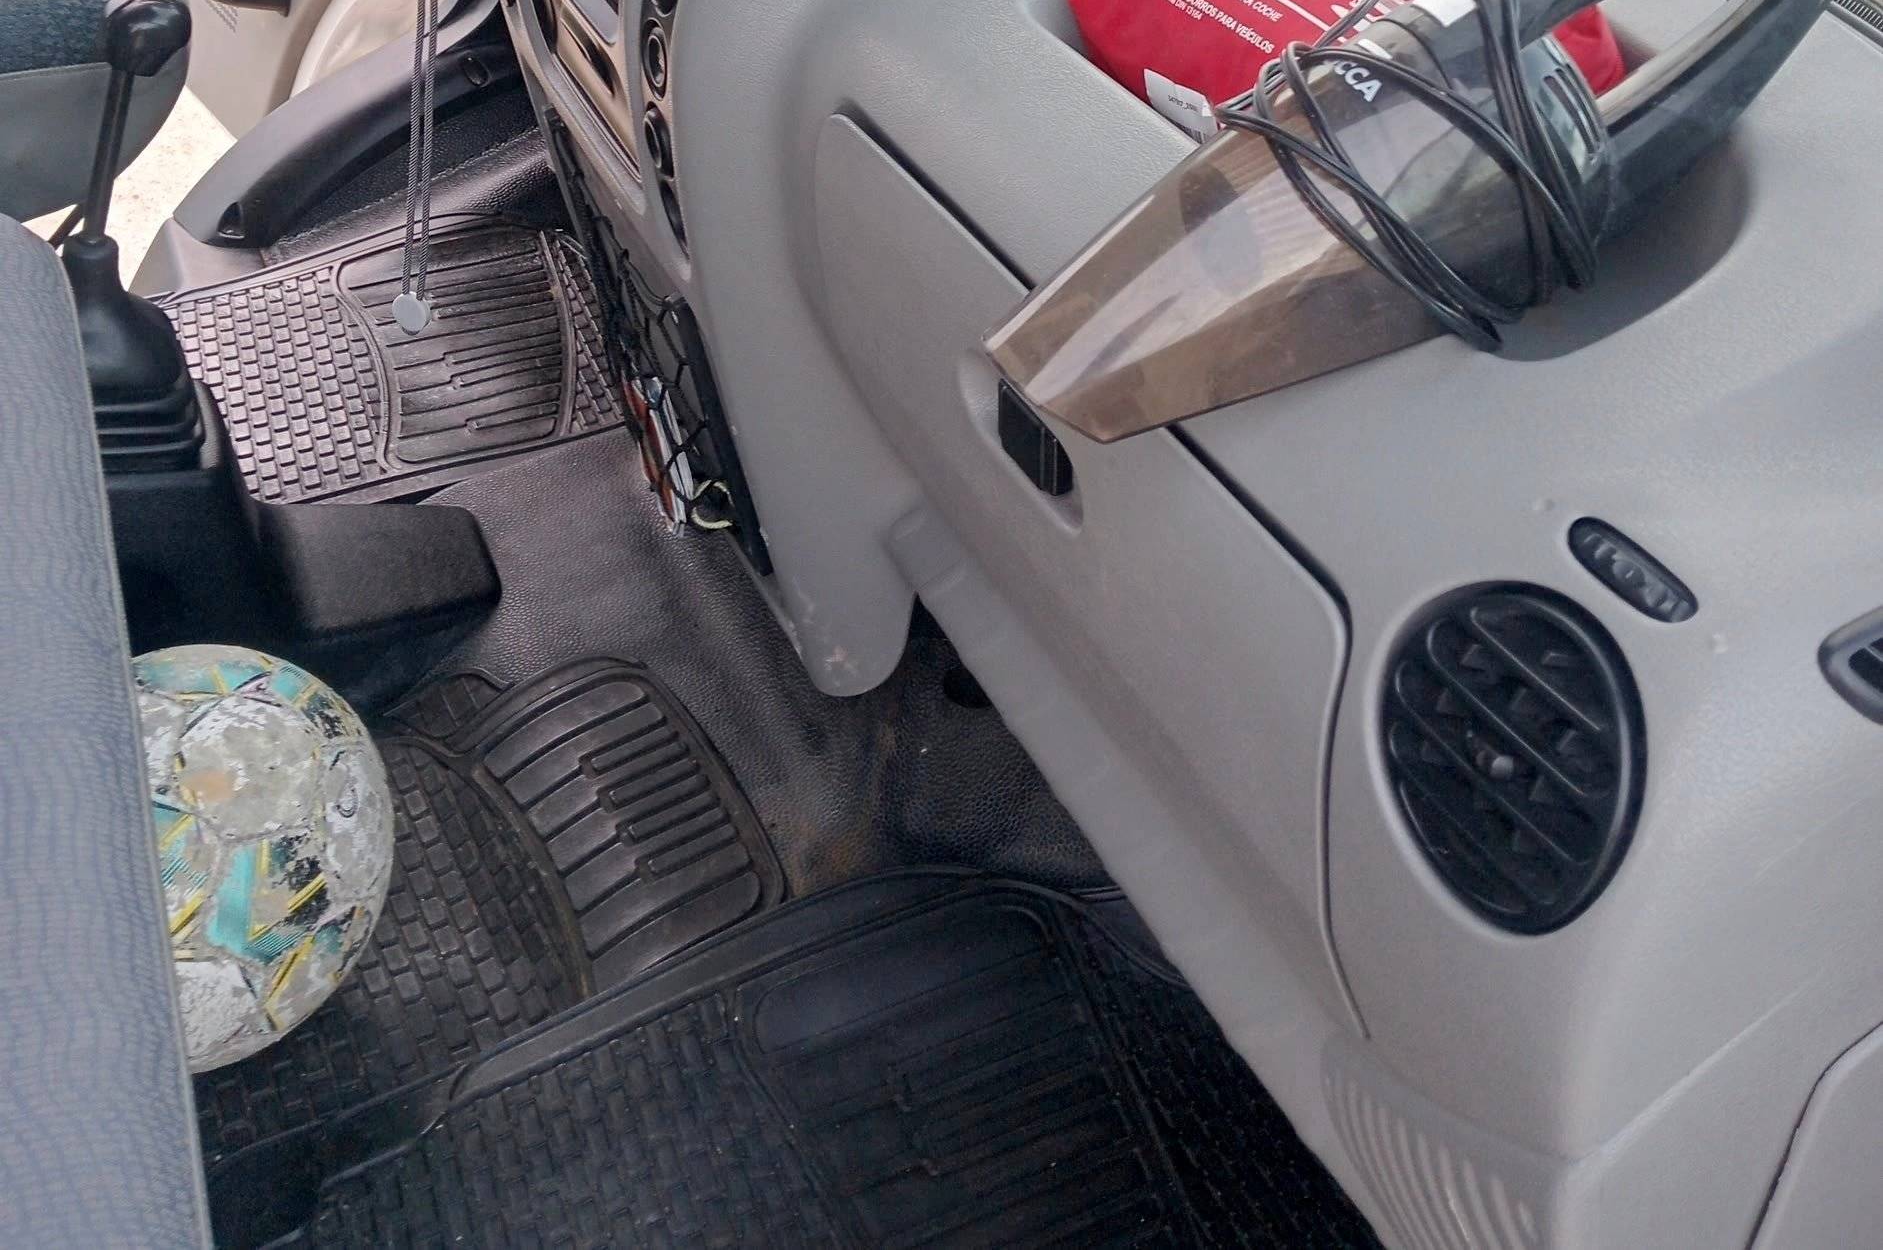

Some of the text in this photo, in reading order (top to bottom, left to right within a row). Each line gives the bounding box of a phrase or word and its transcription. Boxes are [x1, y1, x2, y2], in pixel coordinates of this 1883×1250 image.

[1252, 0, 1284, 22] COCHE
[1214, 11, 1238, 31] PARA
[1235, 22, 1275, 54] VEÍCULOS
[1334, 61, 1382, 102] CCA
